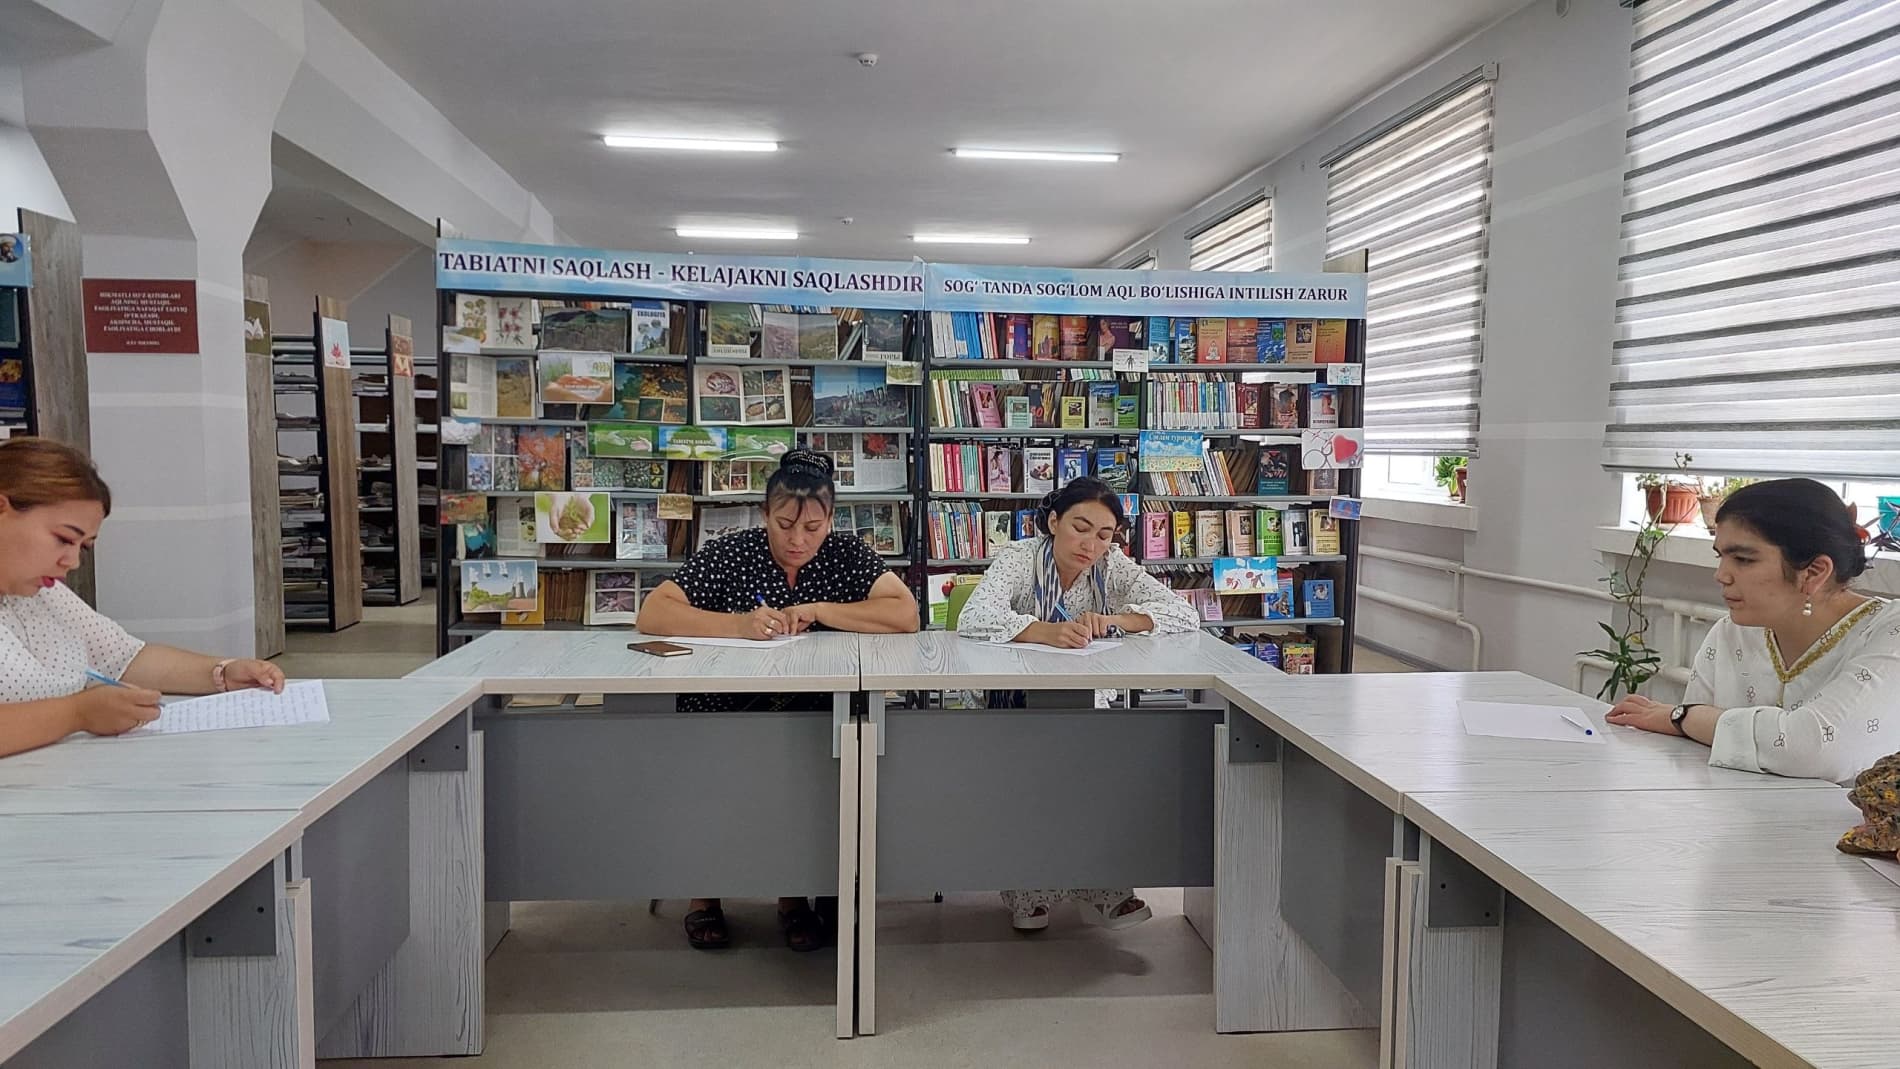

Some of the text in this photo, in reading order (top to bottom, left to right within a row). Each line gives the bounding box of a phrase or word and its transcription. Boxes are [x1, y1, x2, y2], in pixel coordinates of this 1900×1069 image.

[439, 252, 545, 275] TABIATNI
[552, 258, 651, 280] SAQLASH
[671, 264, 786, 288] KELAJAKNI
[792, 271, 923, 293] SAQLASHDIR
[982, 281, 1032, 295] TANDA
[1106, 285, 1136, 300] AQL
[1229, 287, 1293, 300] INTILISH
[1298, 288, 1348, 301] ZARUR
